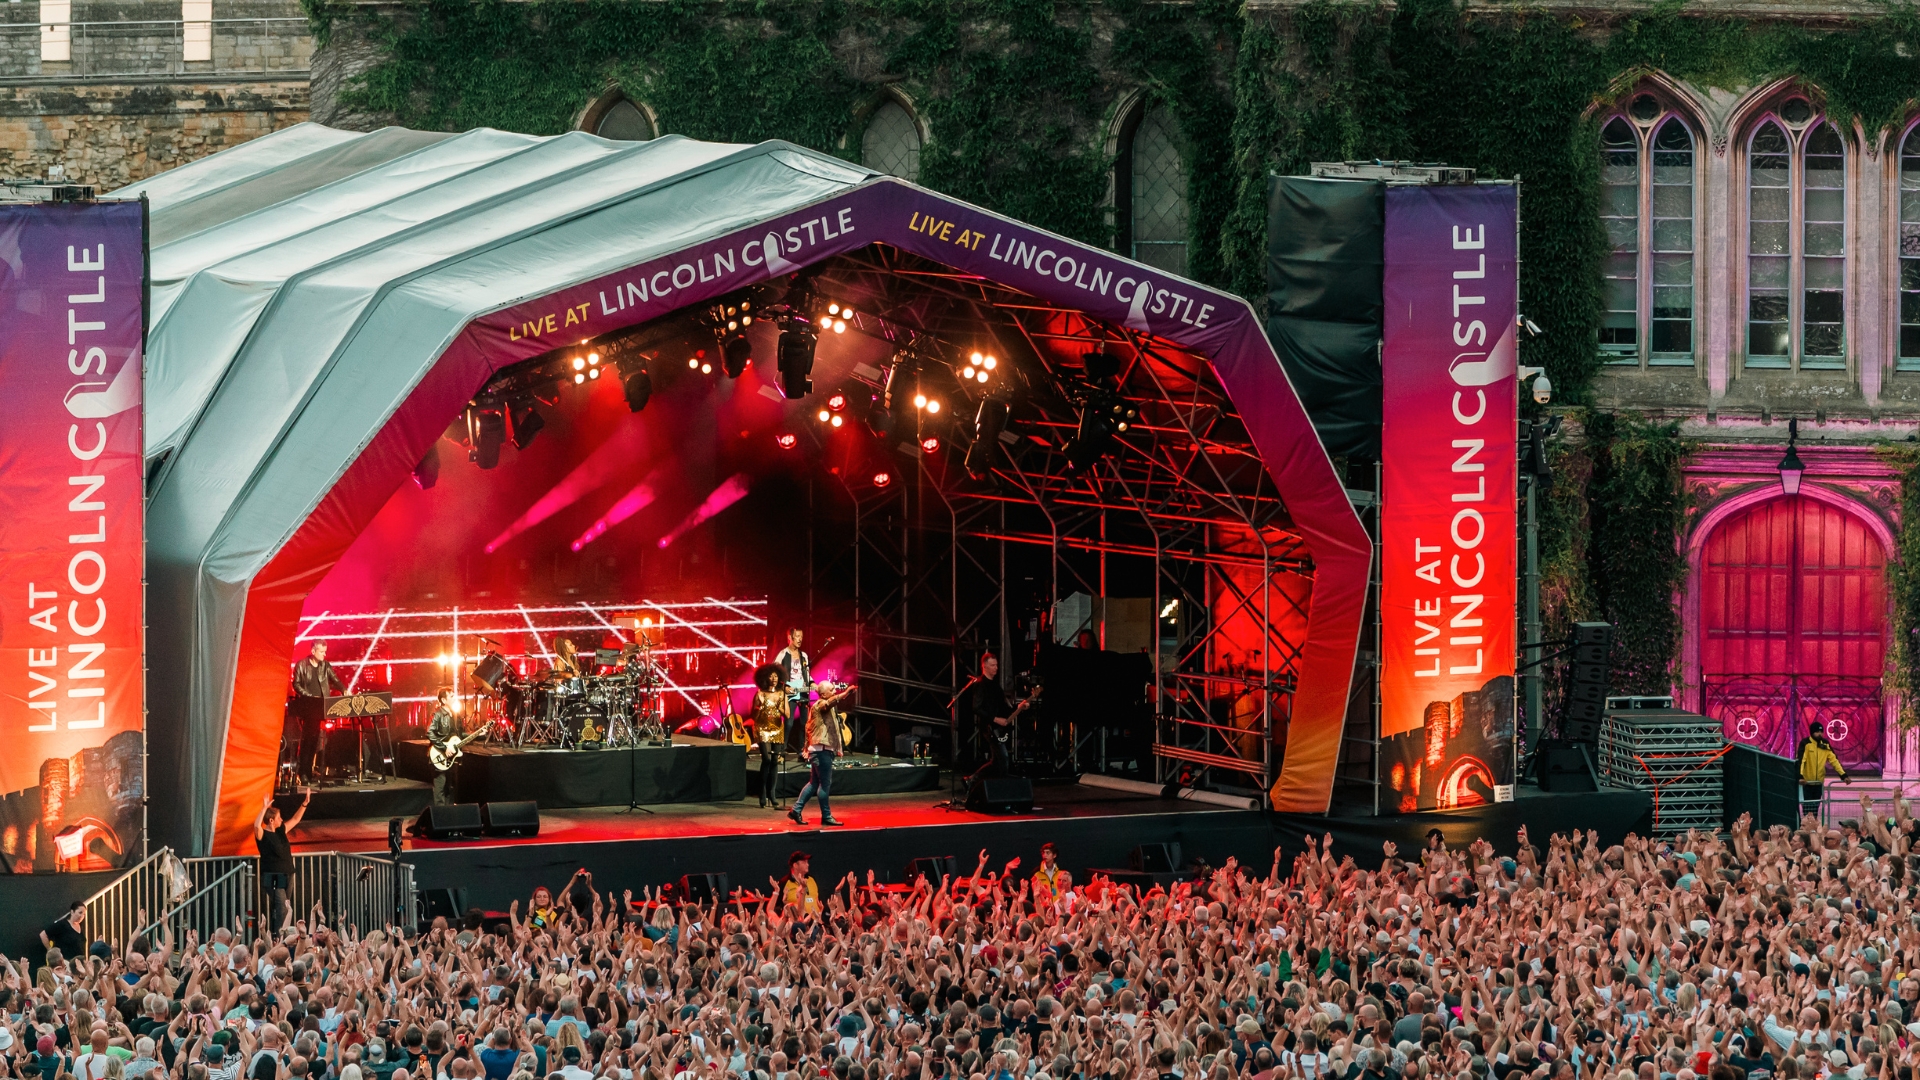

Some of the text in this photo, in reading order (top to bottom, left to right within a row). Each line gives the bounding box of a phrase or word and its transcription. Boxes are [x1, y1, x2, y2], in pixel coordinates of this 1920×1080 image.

[510, 313, 557, 342] LIVE
[565, 302, 590, 325] AT
[599, 248, 736, 316] LINCOLN
[908, 211, 955, 242] LIVE
[954, 229, 986, 251] AT
[989, 233, 1113, 296] LINCOLN
[68, 475, 106, 730] LINCOLN
[1415, 538, 1441, 677] LIVE AT
[1450, 438, 1485, 675] LINCOLN
[29, 583, 57, 733] LIVE AT
